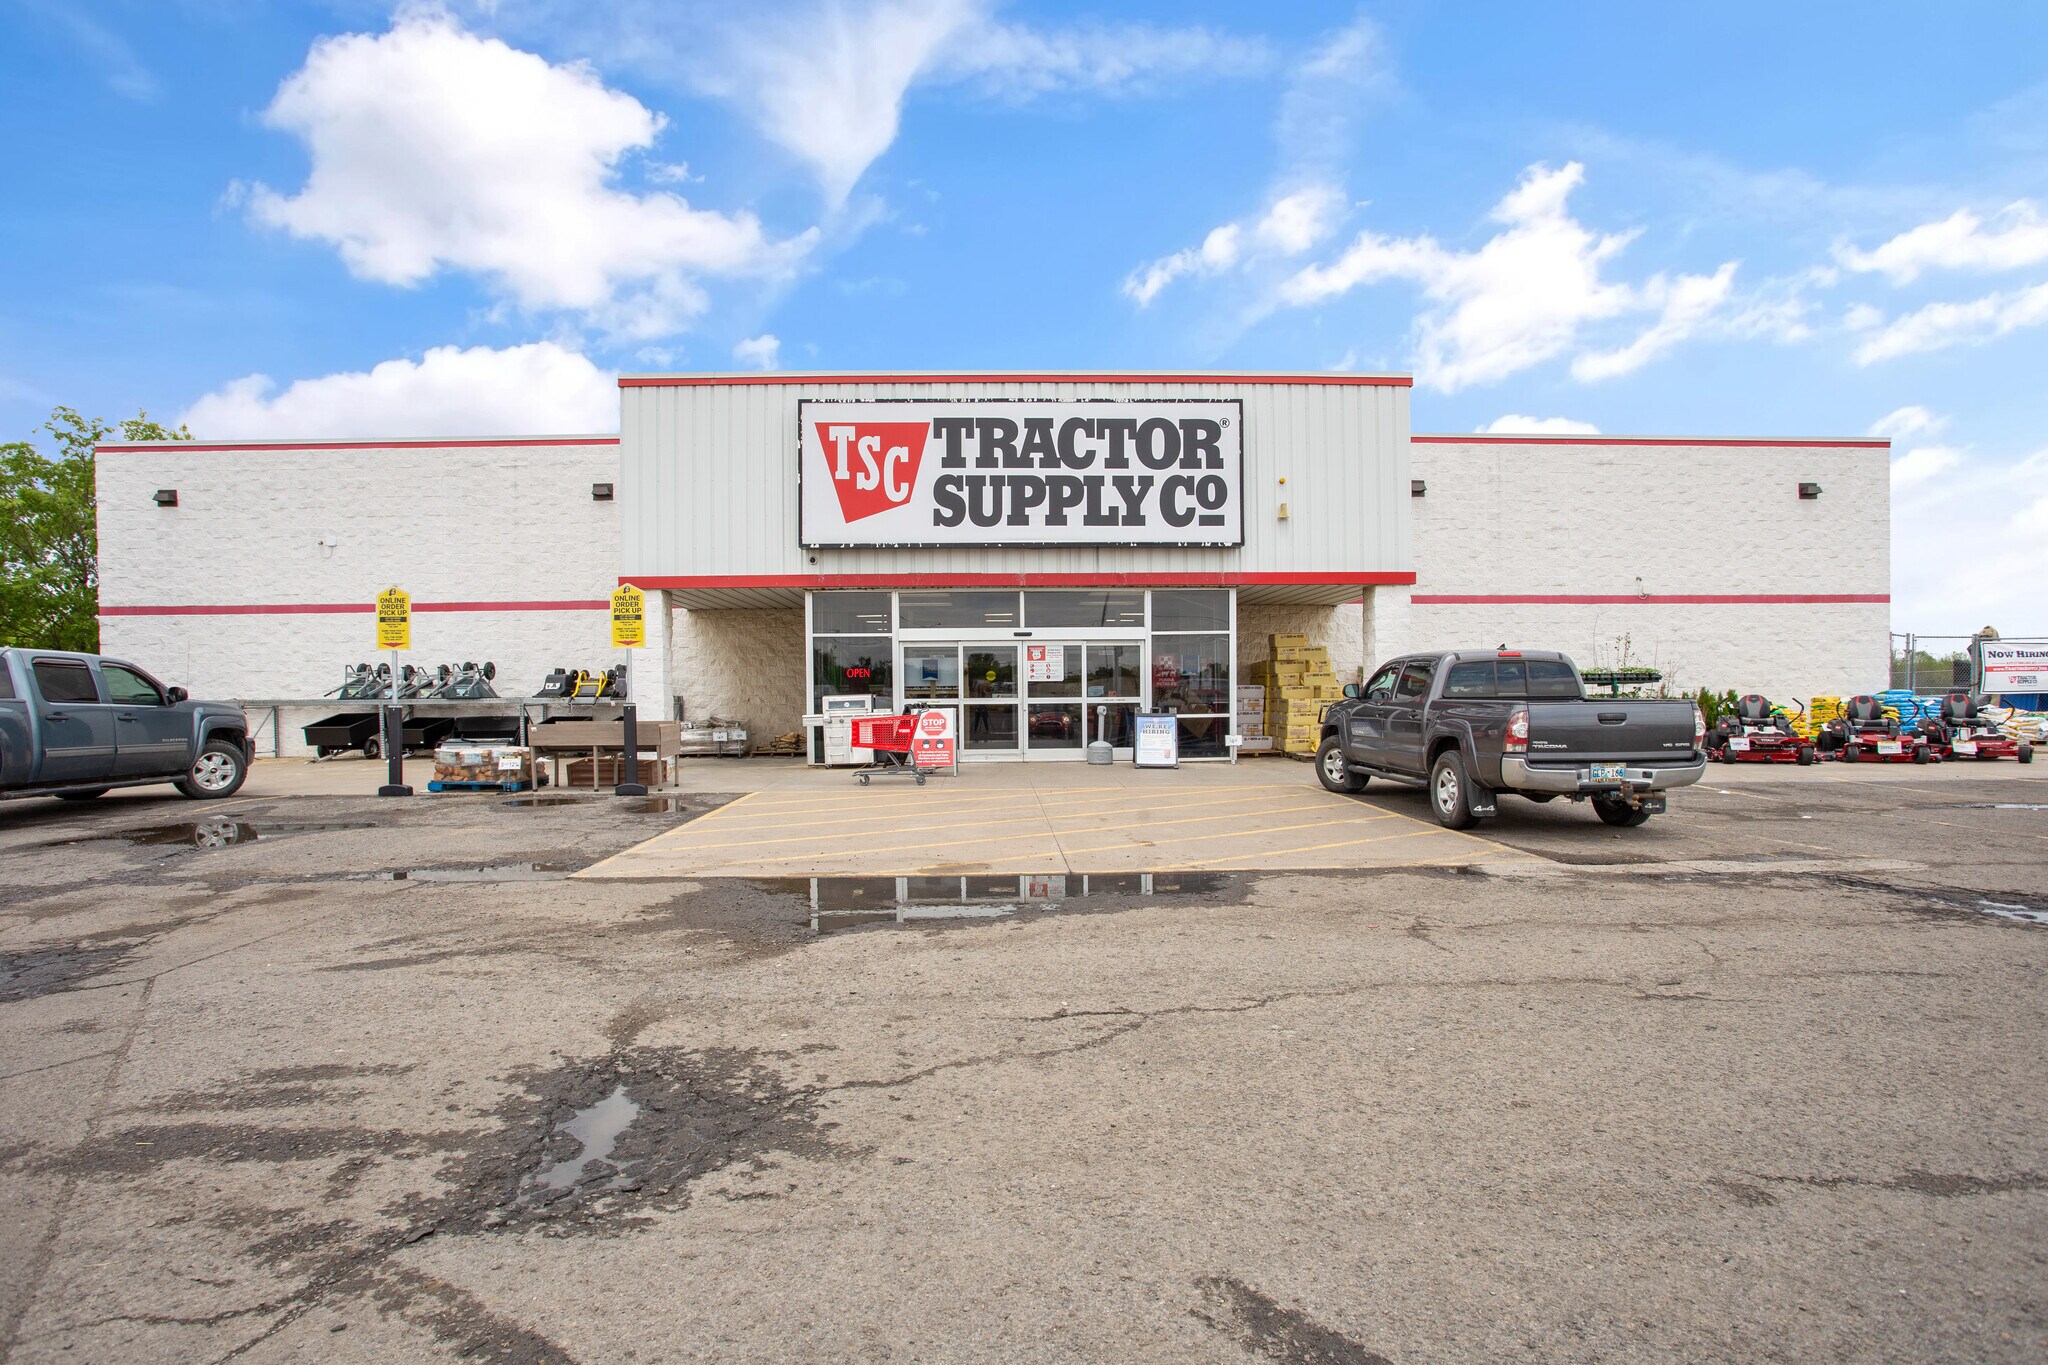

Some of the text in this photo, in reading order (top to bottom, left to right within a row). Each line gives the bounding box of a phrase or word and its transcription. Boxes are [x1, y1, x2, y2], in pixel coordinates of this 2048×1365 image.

[828, 425, 909, 503] TSC
[933, 416, 1225, 470] TRACTOR
[933, 474, 1154, 527] SUPPLY
[846, 668, 871, 678] OPEN
[922, 718, 945, 726] STOP
